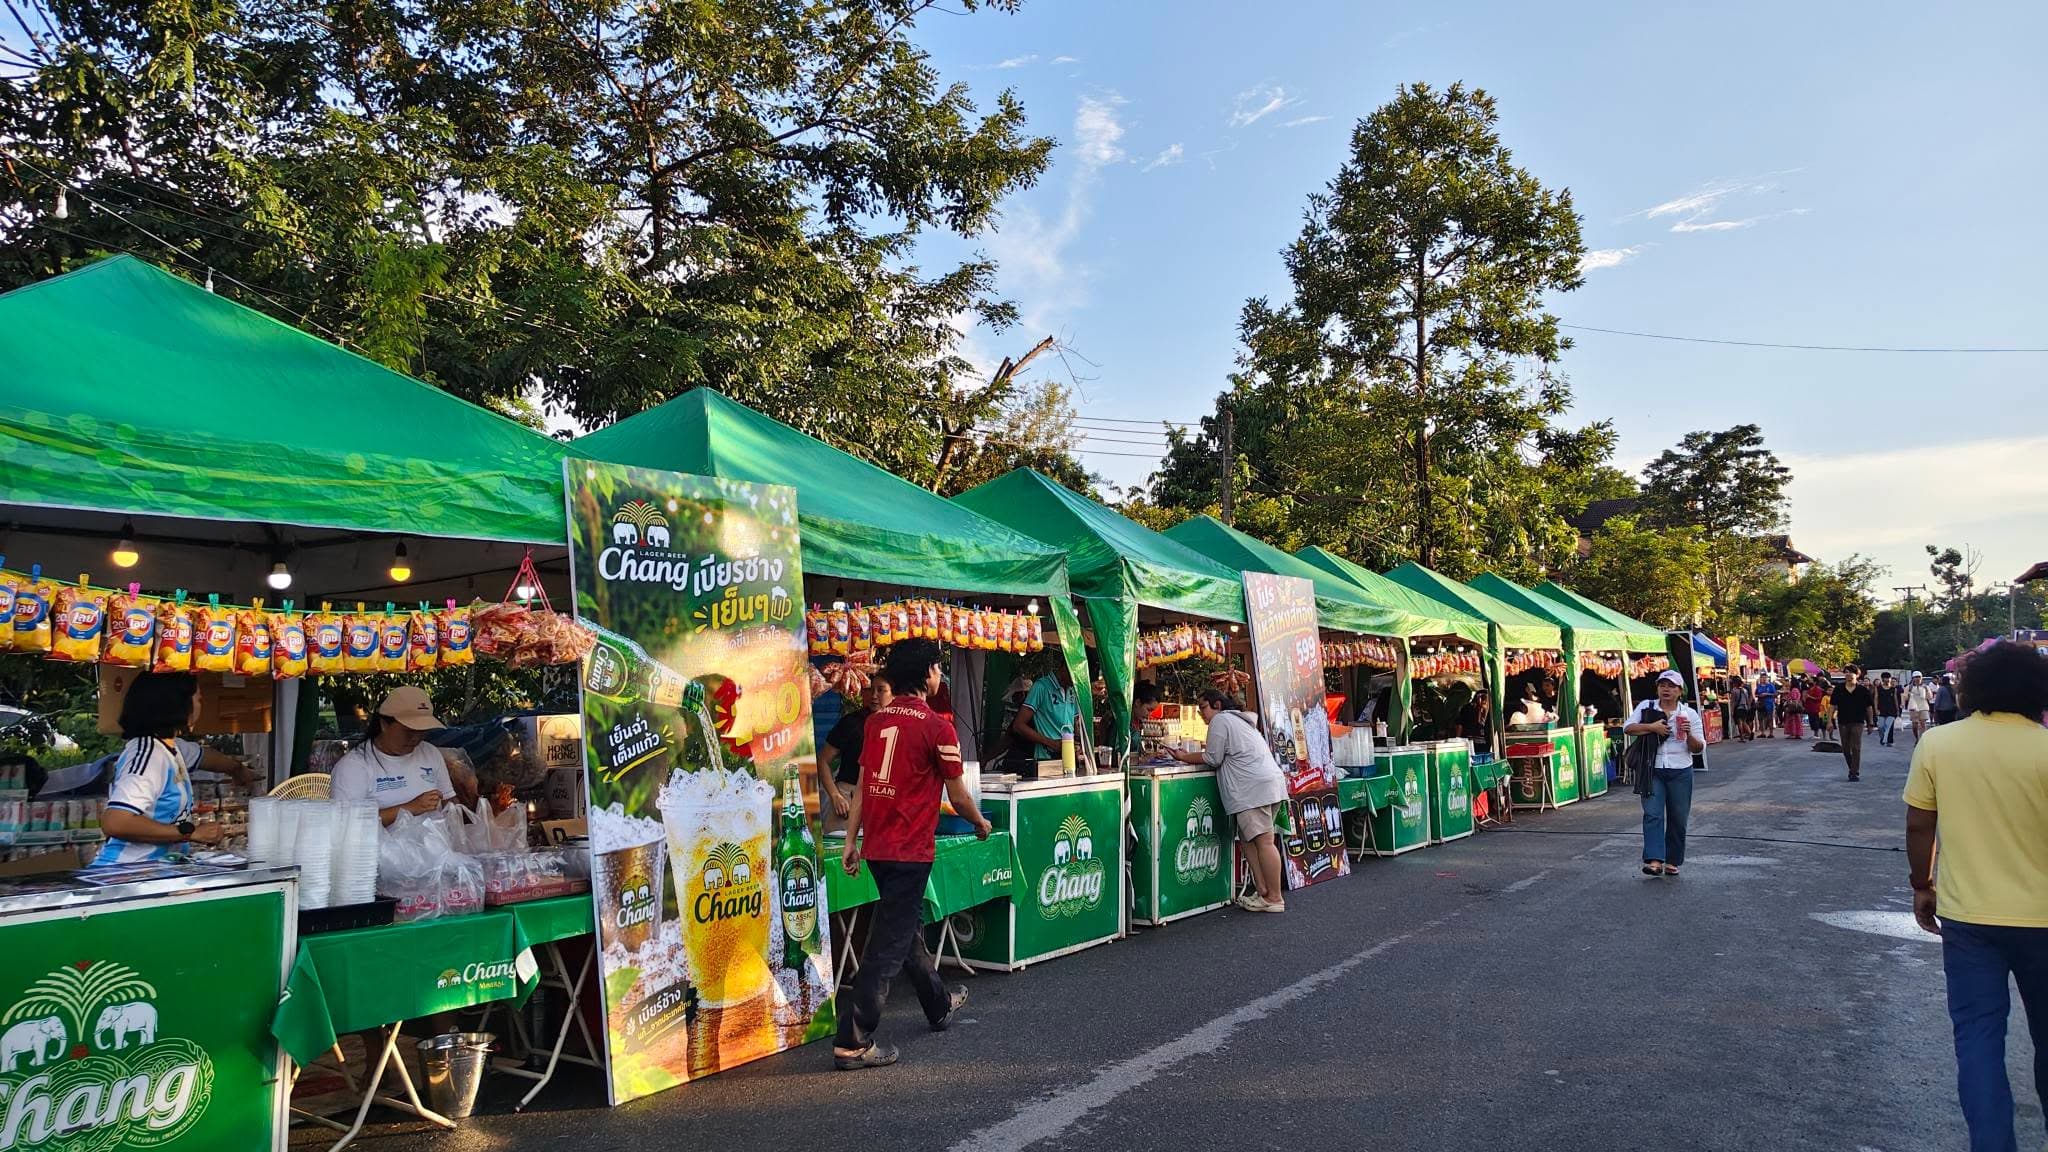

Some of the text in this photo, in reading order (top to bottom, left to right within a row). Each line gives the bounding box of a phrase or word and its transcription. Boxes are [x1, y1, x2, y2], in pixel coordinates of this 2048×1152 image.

[598, 546, 690, 592] Chang
[711, 585, 769, 630] เย็นๆ
[162, 628, 176, 638] 20
[195, 631, 206, 640] 20
[241, 634, 253, 644] 20
[412, 634, 424, 642] 20
[1296, 635, 1316, 666] 599
[588, 646, 609, 691] Chang
[608, 712, 648, 747] เย็นฉ่ำ
[763, 726, 792, 752] บาท
[546, 751, 577, 762] THONG
[547, 744, 573, 753] HONG
[612, 732, 660, 767] เต็มแก้ว
[879, 725, 900, 784] 1
[1448, 790, 1467, 811] Chang
[1176, 838, 1221, 873] Chang
[783, 890, 815, 907] Chang
[1040, 865, 1103, 907] Chang
[616, 901, 655, 929] Chang
[694, 890, 762, 924] Chang
[638, 989, 681, 1025] เบียร์ช้าง
[127, 1134, 160, 1144] NATURAL
